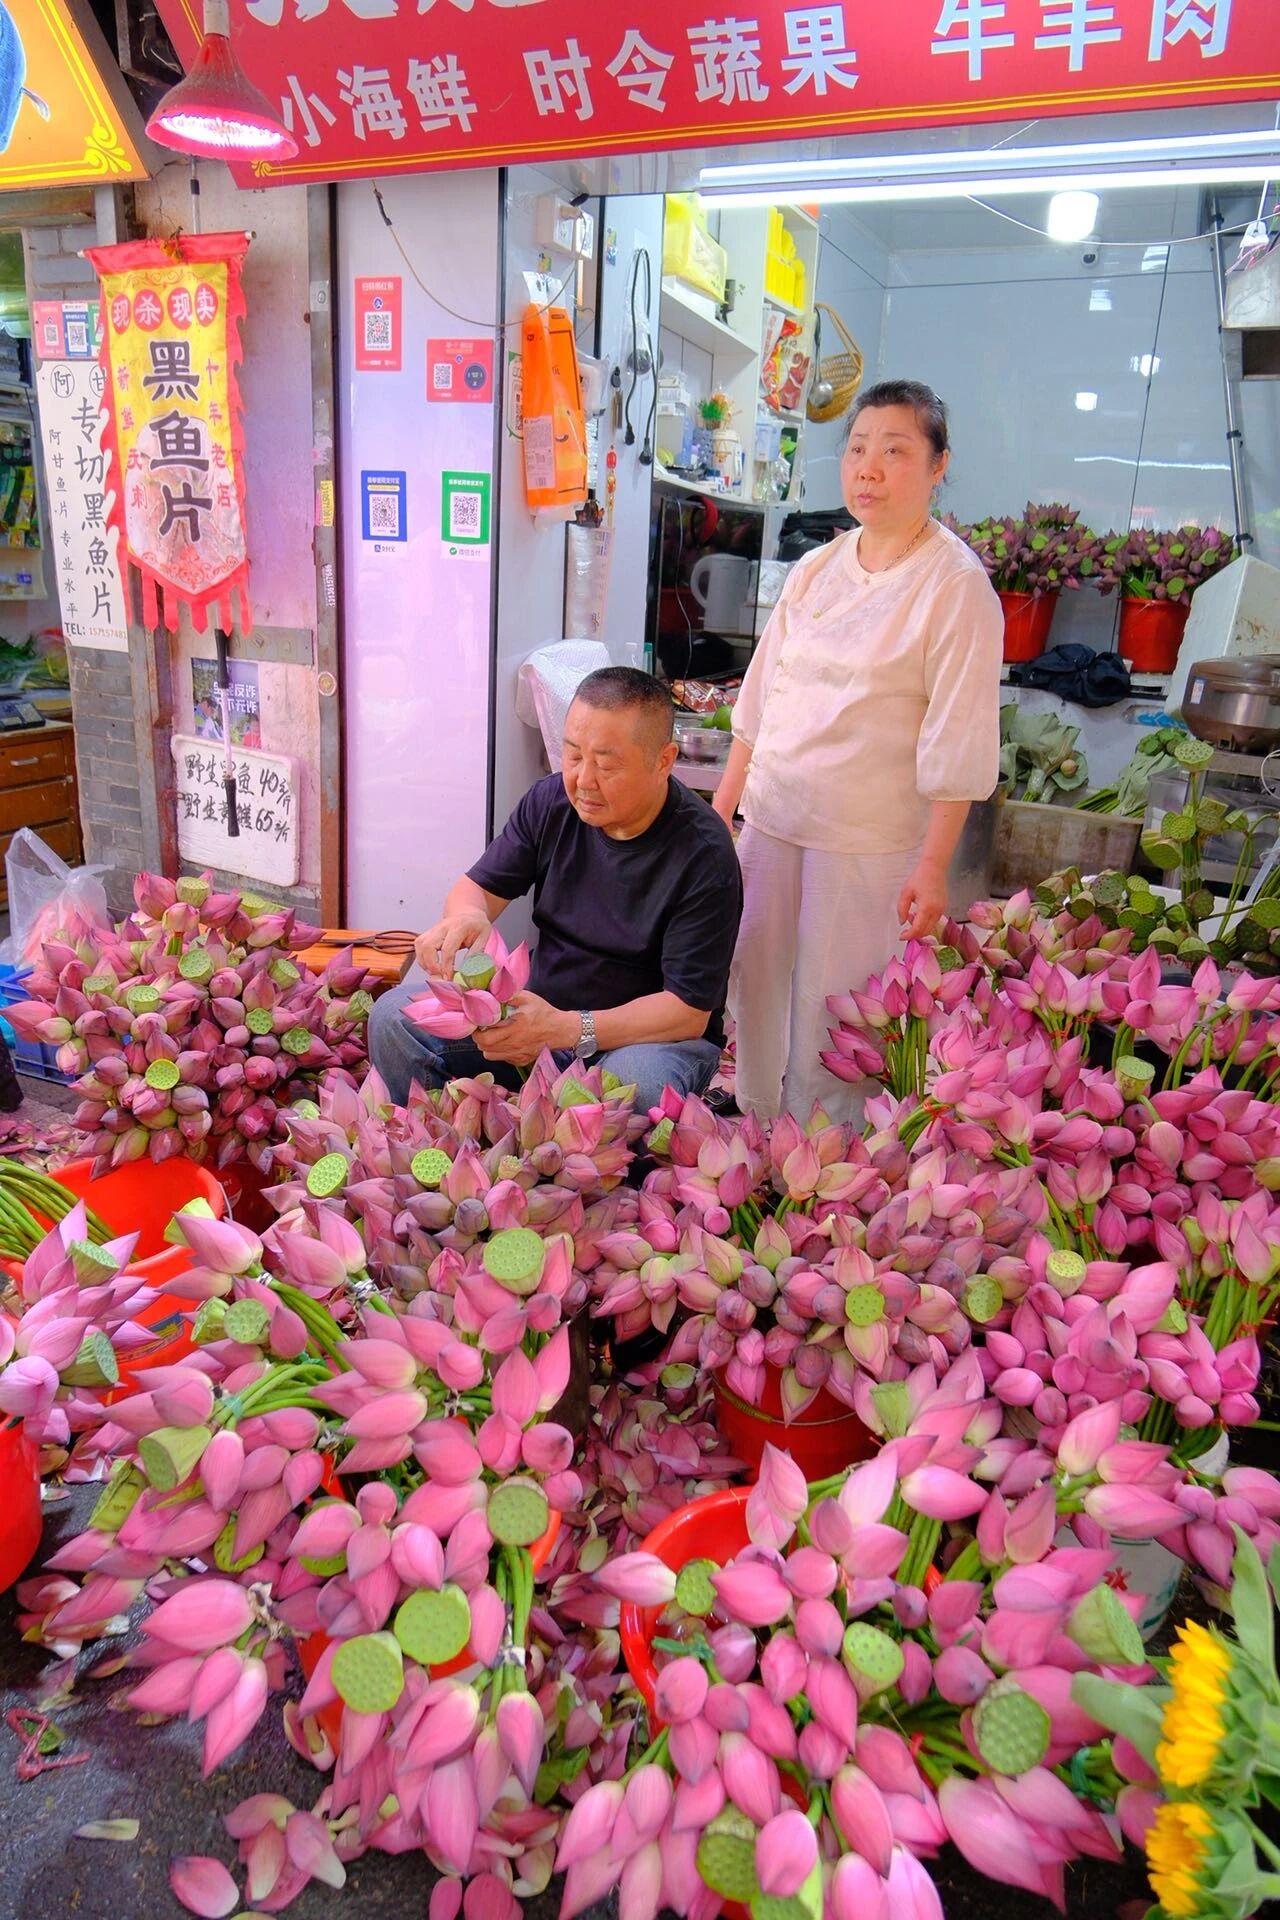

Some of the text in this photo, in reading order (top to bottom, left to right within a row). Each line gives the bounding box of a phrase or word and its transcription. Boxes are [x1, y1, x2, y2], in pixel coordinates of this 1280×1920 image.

[280, 54, 478, 147] 小海鲜
[523, 3, 860, 121] 时令蔬果
[114, 287, 216, 327] 现杀现卖
[143, 341, 214, 542] 黑鱼片
[205, 359, 232, 508] 十年老店
[64, 622, 86, 636] TEL:
